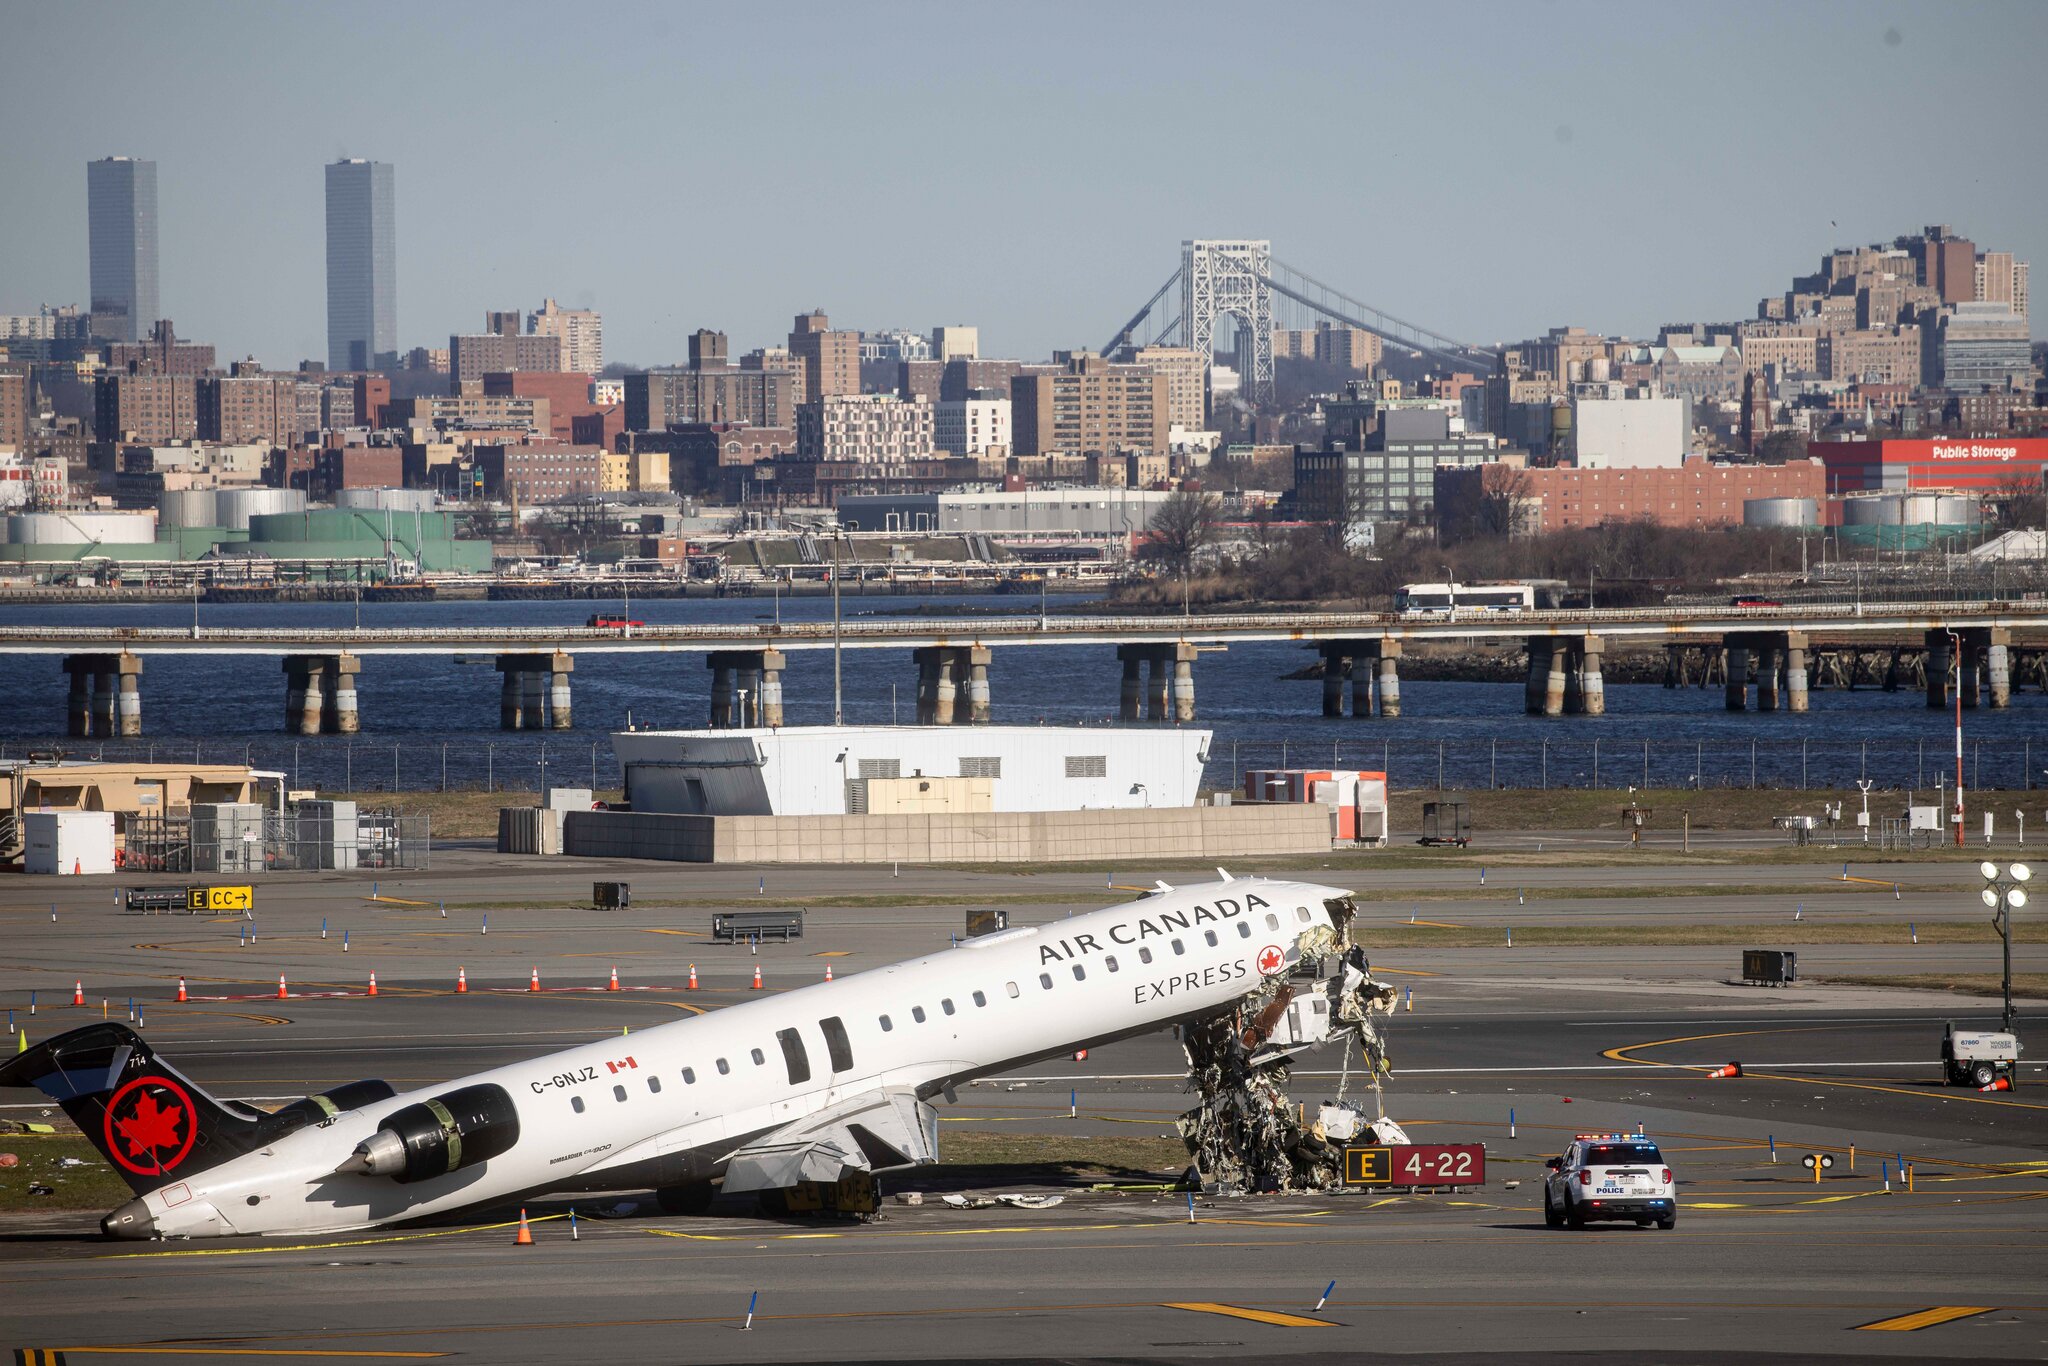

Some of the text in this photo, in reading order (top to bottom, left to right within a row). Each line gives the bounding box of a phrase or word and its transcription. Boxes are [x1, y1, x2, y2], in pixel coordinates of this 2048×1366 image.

[1933, 445, 2017, 461] Public Storage
[194, 892, 203, 906] E
[213, 891, 233, 905] CC
[1039, 893, 1271, 965] AIR CANADA
[1135, 959, 1246, 1004] EXPRESS
[129, 1055, 146, 1068] 714
[530, 1066, 599, 1094] C-GNJZ
[549, 1151, 583, 1165] BOMBARDIER
[1361, 1153, 1376, 1178] E
[1404, 1152, 1472, 1177] 4-22
